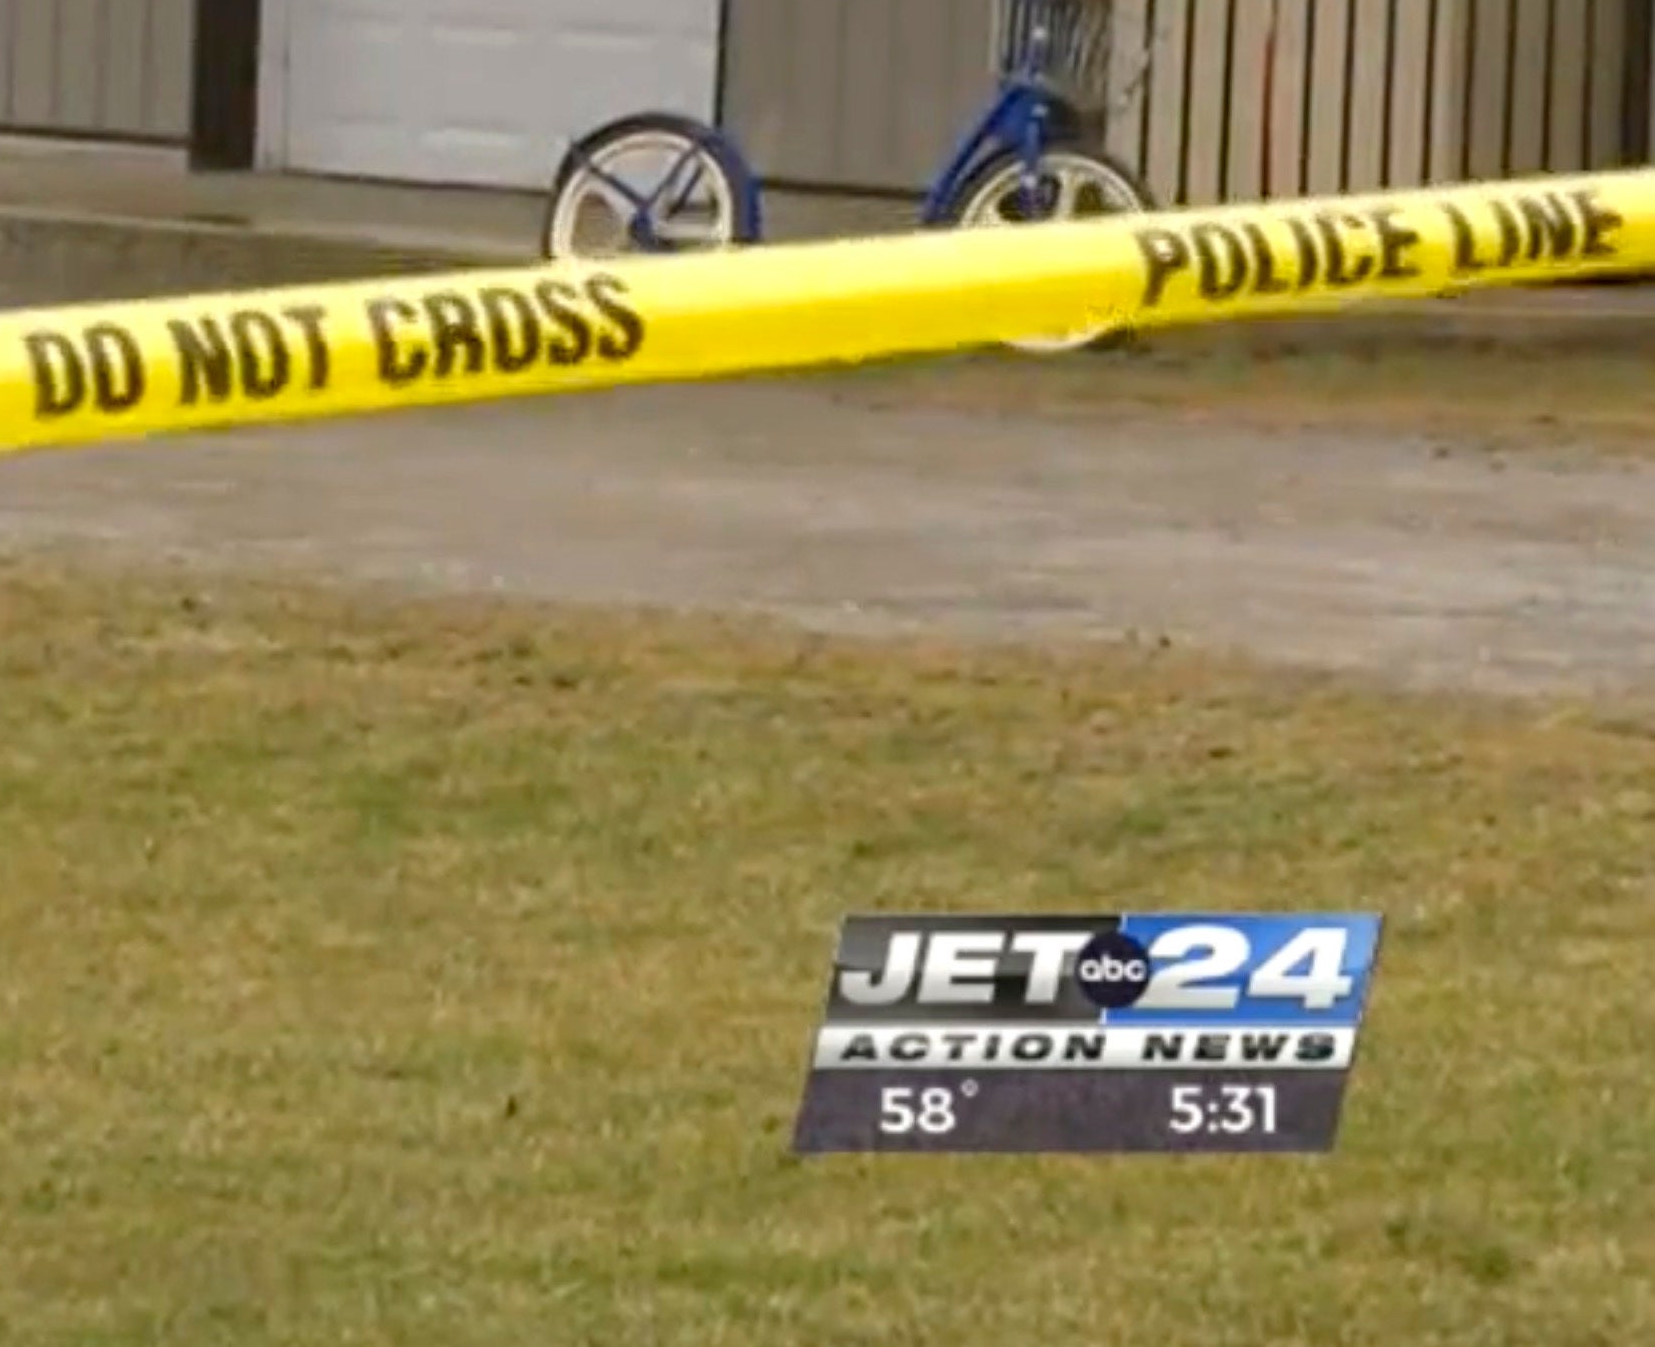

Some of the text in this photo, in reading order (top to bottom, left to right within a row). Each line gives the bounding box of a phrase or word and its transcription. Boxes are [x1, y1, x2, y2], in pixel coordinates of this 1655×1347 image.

[1136, 189, 1624, 308] POLICE LINE
[23, 326, 146, 421] DO
[166, 304, 332, 408] NOT
[365, 271, 645, 392] CROSS
